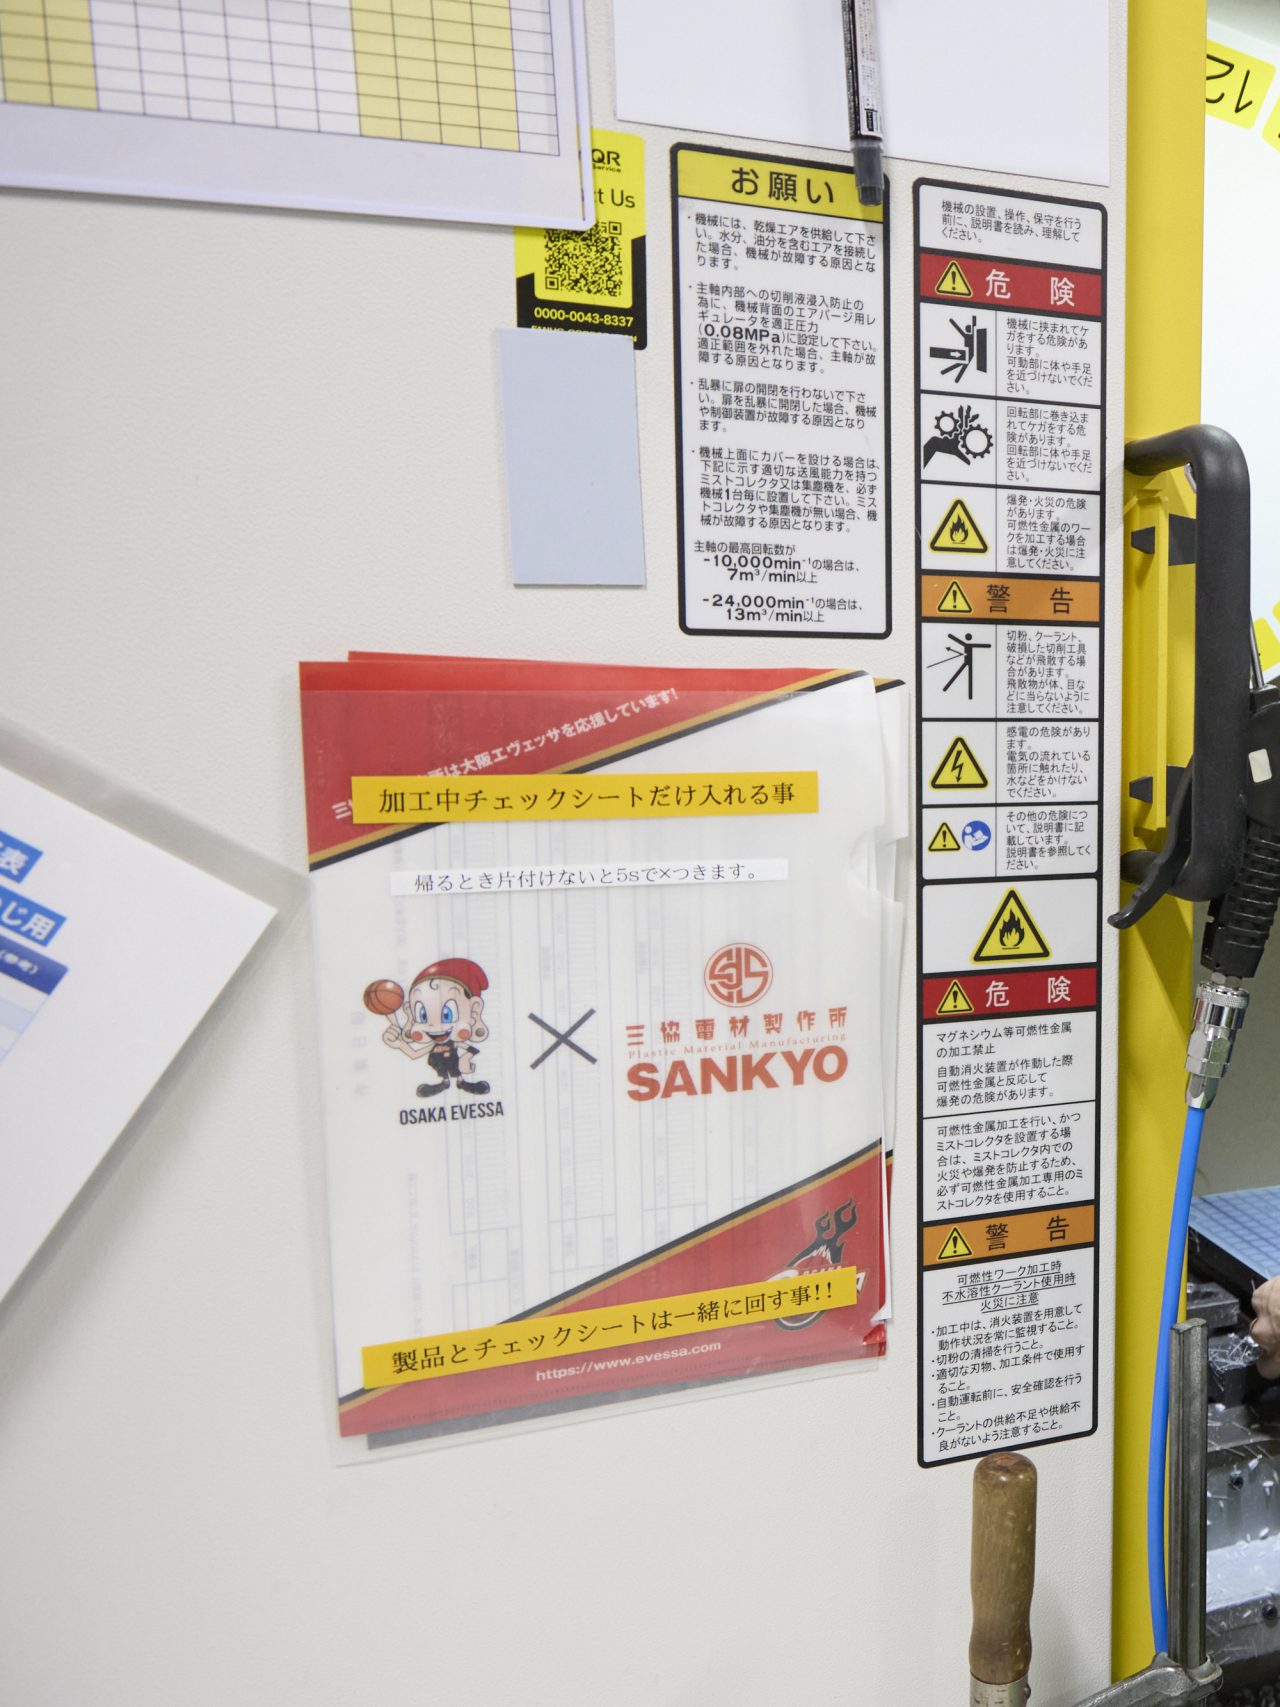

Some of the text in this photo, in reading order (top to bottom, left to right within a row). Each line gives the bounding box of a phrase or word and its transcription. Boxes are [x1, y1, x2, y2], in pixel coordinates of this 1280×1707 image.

[731, 167, 834, 204] お願い
[611, 189, 635, 208] Us
[941, 200, 1081, 230] 機械の設置、操作、保守を行う
[941, 228, 983, 243] ください。
[942, 214, 1080, 242] 前に、説明書を読み、理解して
[697, 256, 739, 270] ります。
[986, 269, 1075, 307] 危険
[534, 307, 633, 327] 0000-0043-8337
[698, 311, 818, 333] ギュレータを適正圧力
[1007, 318, 1089, 336] 機械に挟まれてケ
[1007, 332, 1088, 349] ガをする危険があ
[1007, 345, 1040, 357] ります。
[698, 352, 825, 373] 障する原因となります。
[1007, 356, 1092, 375] 可動部に体や手足
[1007, 369, 1093, 387] を近づけないでくだ
[1007, 383, 1030, 395] さい。
[699, 407, 864, 429] や制御装置が故障する原因となり
[1007, 406, 1089, 423] 回転部に巻き込ま
[700, 420, 728, 432] ます。
[1007, 420, 1086, 436] れてケガをする危
[1007, 433, 1071, 448] 険があります。
[1007, 445, 1091, 461] 回転部に体や手足
[1007, 458, 1093, 474] を近づけないでくだ
[1007, 471, 1030, 482] さい。
[1007, 494, 1087, 510] 爆発・火災の危険
[1007, 508, 1060, 521] があります。
[701, 515, 851, 532] 械が故障する原因となります。
[1007, 520, 1090, 533] 可燃性金属のワー
[1007, 533, 1086, 546] クを加工する場合
[694, 541, 796, 556] 主軸の最高回転数が
[1007, 545, 1086, 559] は爆発・火災に注
[1007, 558, 1075, 571] 意してください。
[986, 584, 1074, 615] 警告
[1007, 630, 1083, 643] 切粉、クーラント、
[1007, 642, 1086, 655] 破損した切削工具
[1007, 654, 1086, 667] などが飛散する場
[1007, 666, 1069, 678] 合があります。
[1007, 678, 1085, 690] 飛散物が体、目な
[1007, 690, 1090, 702] どに当らないように
[1007, 702, 1083, 715] 注意してください。
[1007, 726, 1090, 738] 感電の危険があり
[1007, 739, 1032, 750] ます。
[1007, 750, 1090, 761] 電気の流れている
[1007, 762, 1083, 774] 箇所に触れたり、
[1007, 775, 1088, 786] 水などをかけない
[379, 780, 796, 814] 加工中チェックシートだけ入れる事
[1007, 787, 1057, 798] でください。
[1007, 811, 1088, 822] その他の危険につ
[1006, 822, 1084, 834] いて、説明書に記
[1007, 834, 1068, 846] 載しています。
[1006, 845, 1091, 859] 説明書を参照してく
[1006, 859, 1039, 870] ださい。
[985, 976, 1071, 1008] 危険
[626, 1007, 847, 1046] 三協電材製作所
[936, 1021, 1072, 1044] マグネシウム等可燃性金属
[628, 1033, 847, 1059] Plastic Material Manufacturing
[936, 1043, 996, 1059] の加工禁止
[627, 1045, 848, 1102] SANKYO
[937, 1054, 1073, 1078] 自動消火装置が作動した際
[937, 1072, 1048, 1093] 可燃性金属と反応して
[936, 1087, 1055, 1108] 爆発の危険があります。
[400, 1101, 504, 1125] OSAKA EVESSA
[937, 1113, 1081, 1138] 可燃性金属加工を行い、かつ
[936, 1127, 1071, 1151] ミストコレクタを設置する場
[937, 1142, 1073, 1167] 合は、ミストコレクタ内での
[937, 1157, 1077, 1182] 火災や爆発を防止するため、
[936, 1170, 1084, 1197] 必ず可燃性金属加工専用のミ
[937, 1186, 1070, 1211] ストコレクタを使用すること。
[986, 1216, 1070, 1252] 警告
[957, 1261, 1062, 1285] 可燃性ワーク加工時
[942, 1273, 1076, 1302] 不水溶性クーラント使用時
[981, 1292, 1039, 1311] 火災に注意
[392, 1281, 834, 1375] 製品とチェックシートは一緒に回す事!!
[938, 1320, 1080, 1351] 動作状況を常に監視すること。
[535, 1340, 721, 1382] https://www.evessa.com
[938, 1381, 971, 1394] ること。
[938, 1410, 961, 1422] こと。
[938, 1422, 1064, 1452] 良がないよう注意すること。
